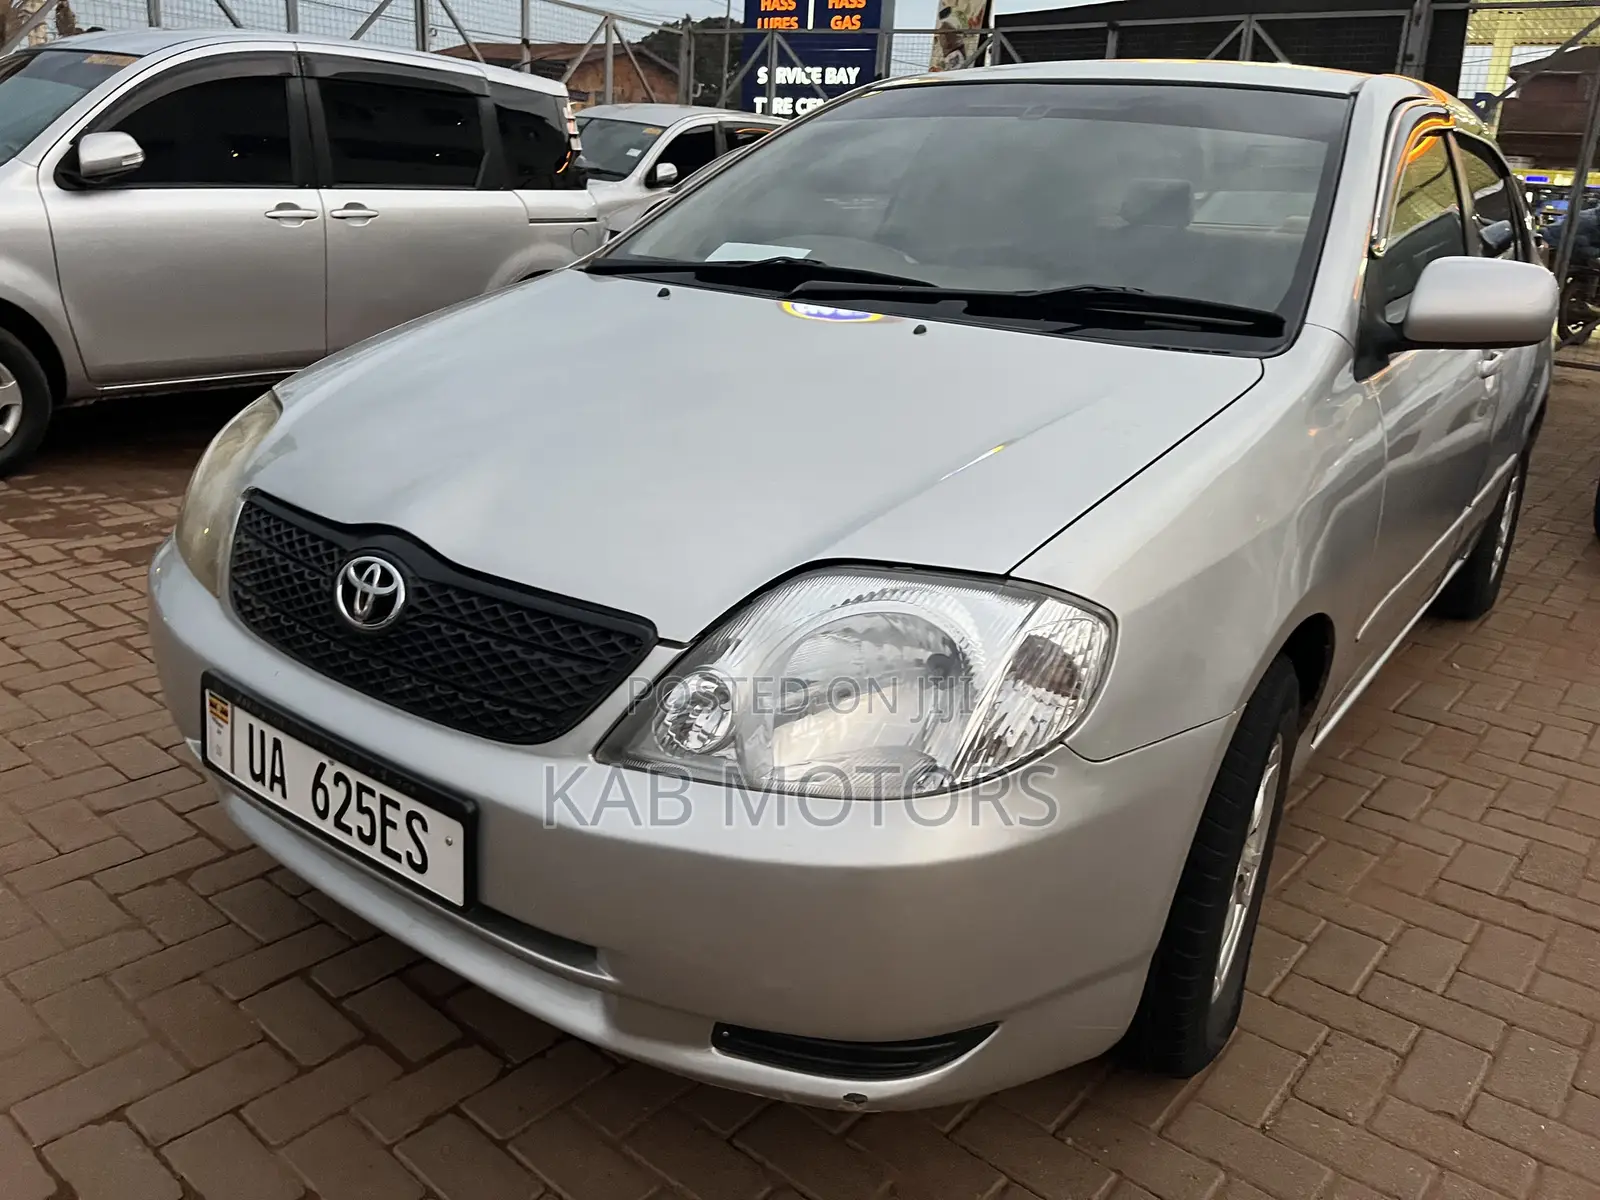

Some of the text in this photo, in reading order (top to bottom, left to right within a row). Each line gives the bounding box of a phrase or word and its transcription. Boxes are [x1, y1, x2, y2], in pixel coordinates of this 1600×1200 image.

[760, 0, 797, 11] HASS
[830, 14, 862, 30] GAS
[757, 66, 860, 85] SRVICE BAY
[753, 96, 794, 115] TRE
[248, 722, 429, 875] UA 625ES
